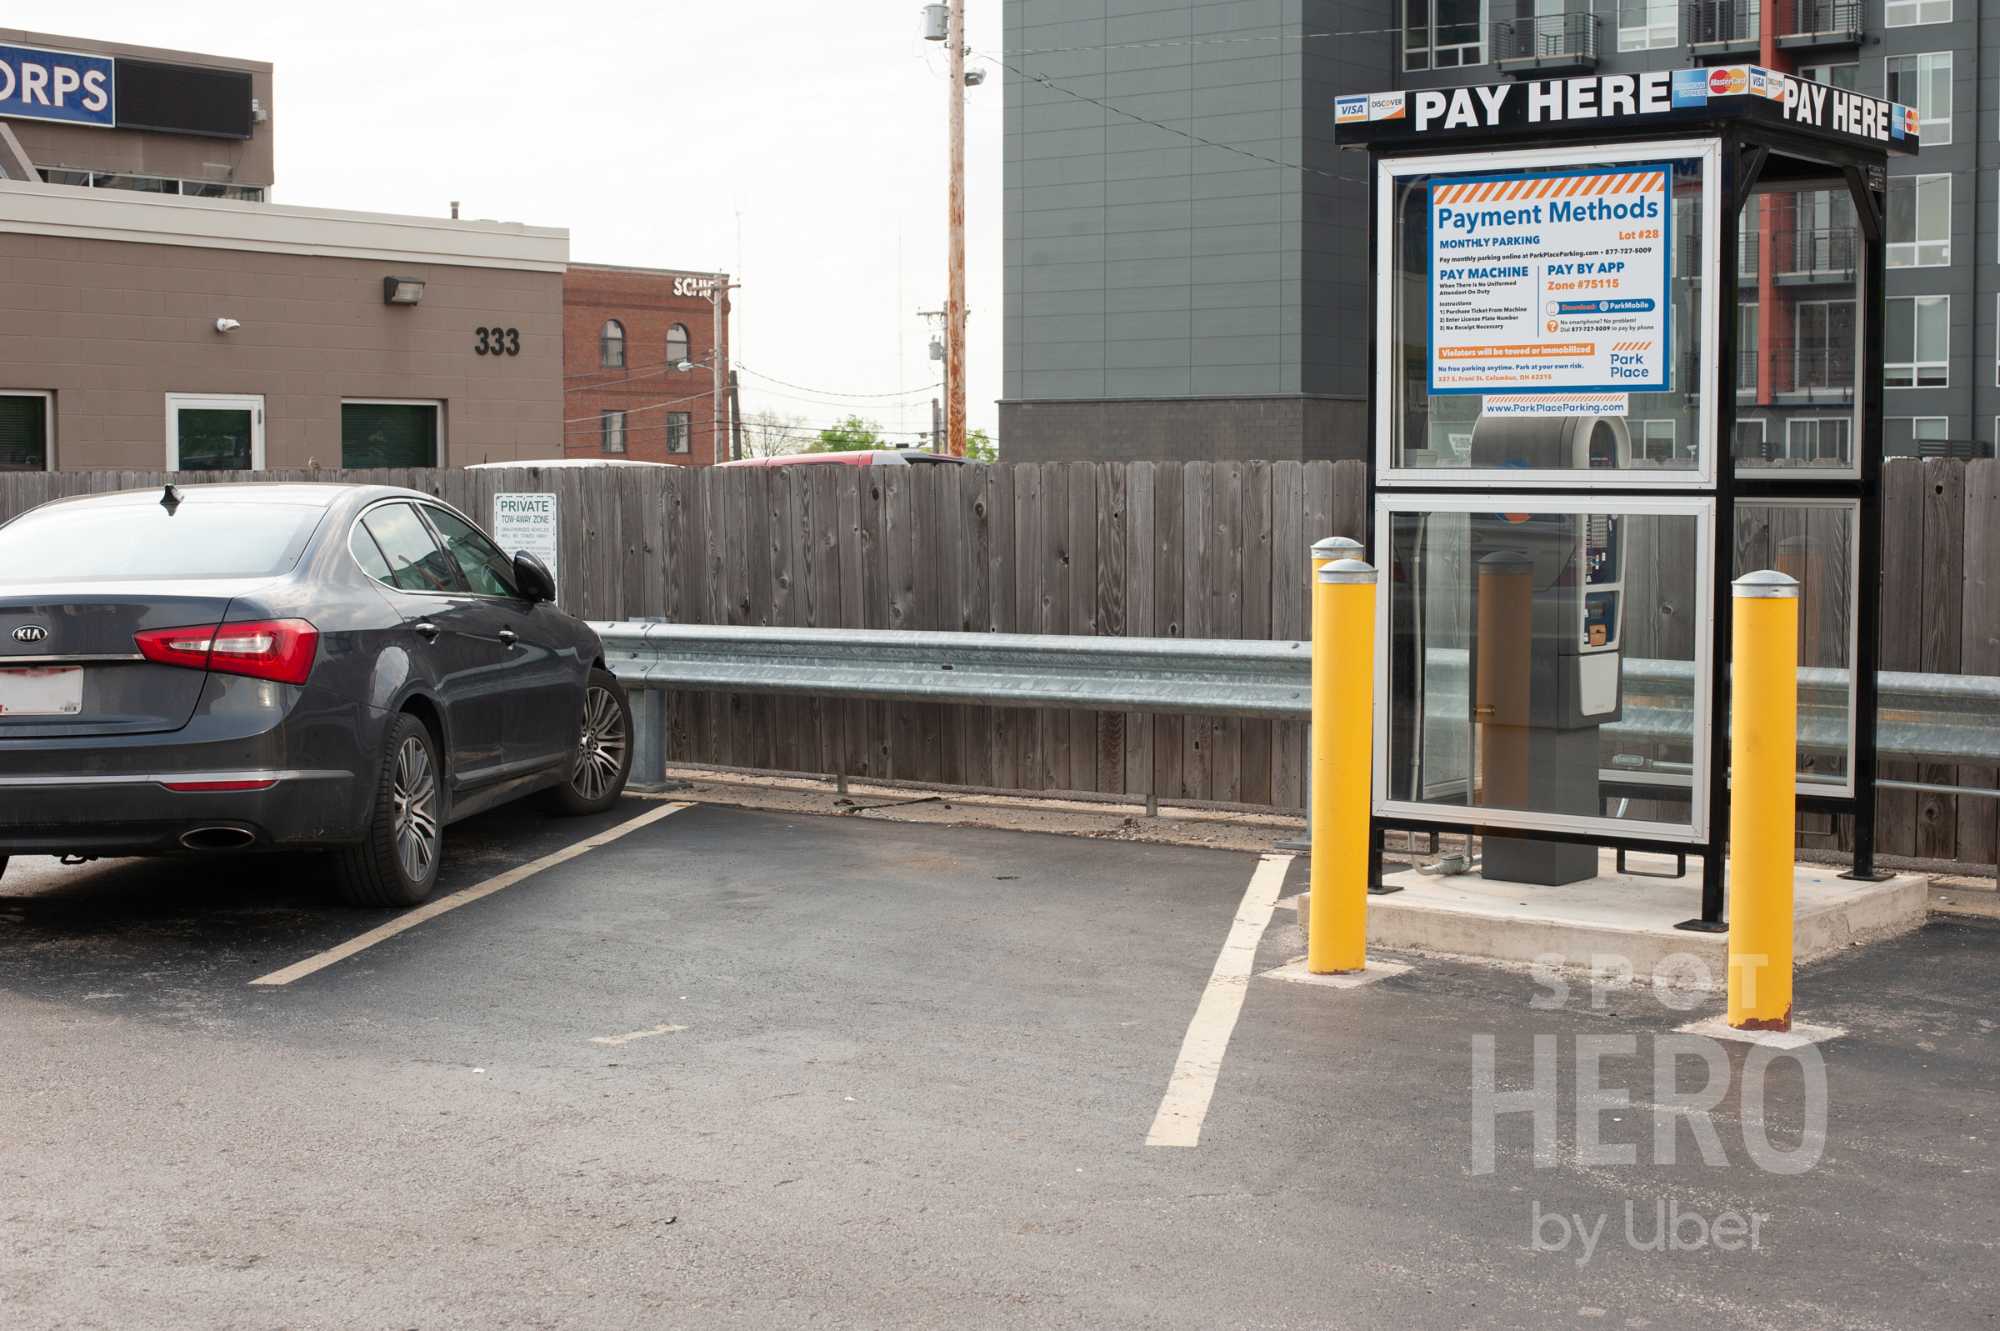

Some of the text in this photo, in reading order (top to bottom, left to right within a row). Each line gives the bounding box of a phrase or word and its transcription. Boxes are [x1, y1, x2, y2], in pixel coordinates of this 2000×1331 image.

[1372, 98, 1402, 109] DISCOVER
[1415, 71, 1671, 132] PAY HERE
[1342, 103, 1364, 115] VISA
[1783, 78, 1889, 142] PAY HERE
[1438, 195, 1658, 234] Payment Methods
[1619, 229, 1659, 240] Lot #28
[1440, 235, 1540, 249] MONTHLY PARKING
[1451, 255, 1476, 263] monthly
[1477, 254, 1501, 262] parking
[1529, 249, 1599, 259] ParkPlaceParking.com
[1605, 246, 1652, 255] 877-727-5009
[1440, 266, 1529, 280] PAY MACHINE
[1547, 261, 1625, 276] PAY BY APP
[1548, 278, 1620, 290] Zone #75115
[1609, 301, 1649, 310] ParkMobile
[474, 326, 520, 357] 333
[1441, 348, 1476, 358] Violators
[1503, 346, 1530, 355] towed
[1541, 344, 1591, 354] immobilized
[1610, 353, 1643, 365] Park
[1461, 365, 1485, 373] parking
[1487, 363, 1514, 371] anytime.
[1610, 366, 1648, 378] Place
[1487, 402, 1624, 414] www.ParkPlaceParking.com
[501, 500, 549, 513] PRIVATE
[533, 514, 549, 524] ZONE
[17, 628, 42, 640] KIA
